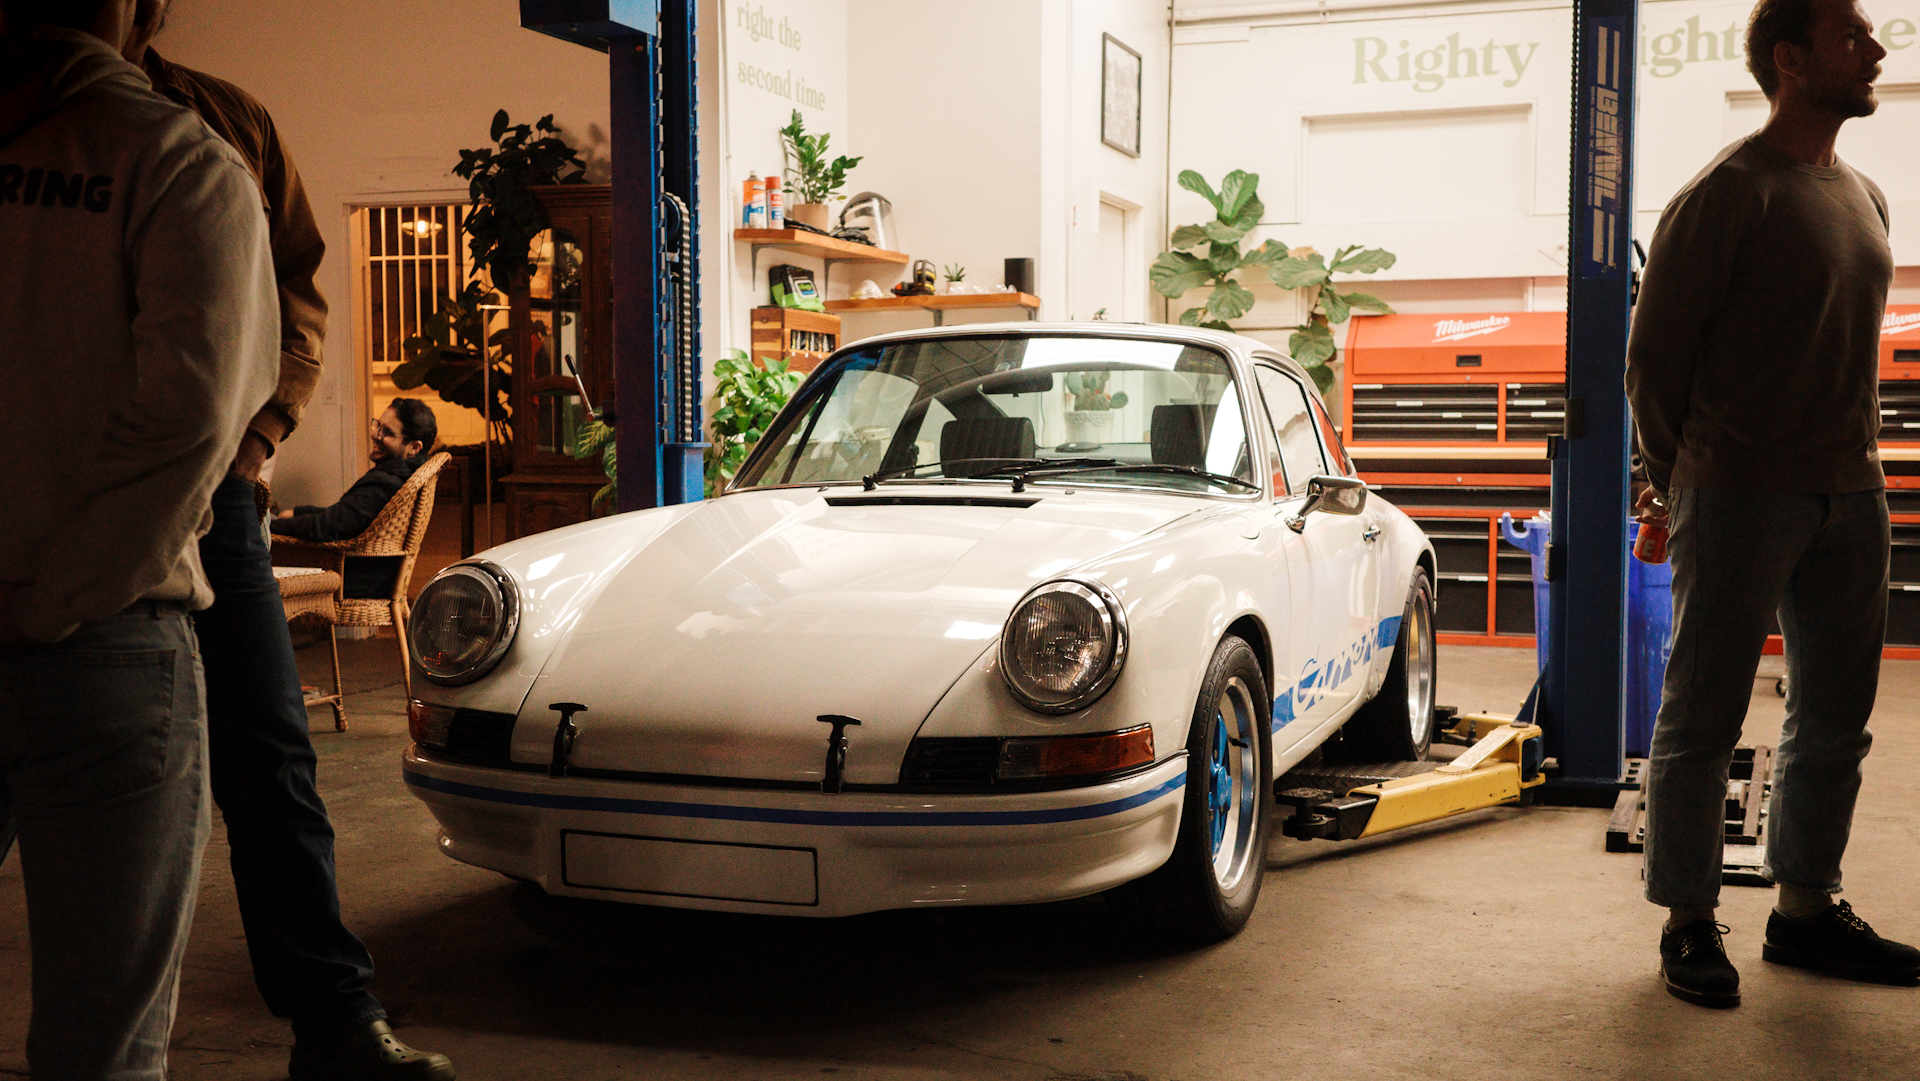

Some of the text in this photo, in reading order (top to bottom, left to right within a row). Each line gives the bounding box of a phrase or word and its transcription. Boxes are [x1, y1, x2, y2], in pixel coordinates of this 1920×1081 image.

[737, 0, 802, 51] right the
[1351, 14, 1743, 93] Righty ight
[738, 61, 826, 111] second time
[0, 164, 114, 213] RING
[1433, 315, 1511, 337] Milwaukee
